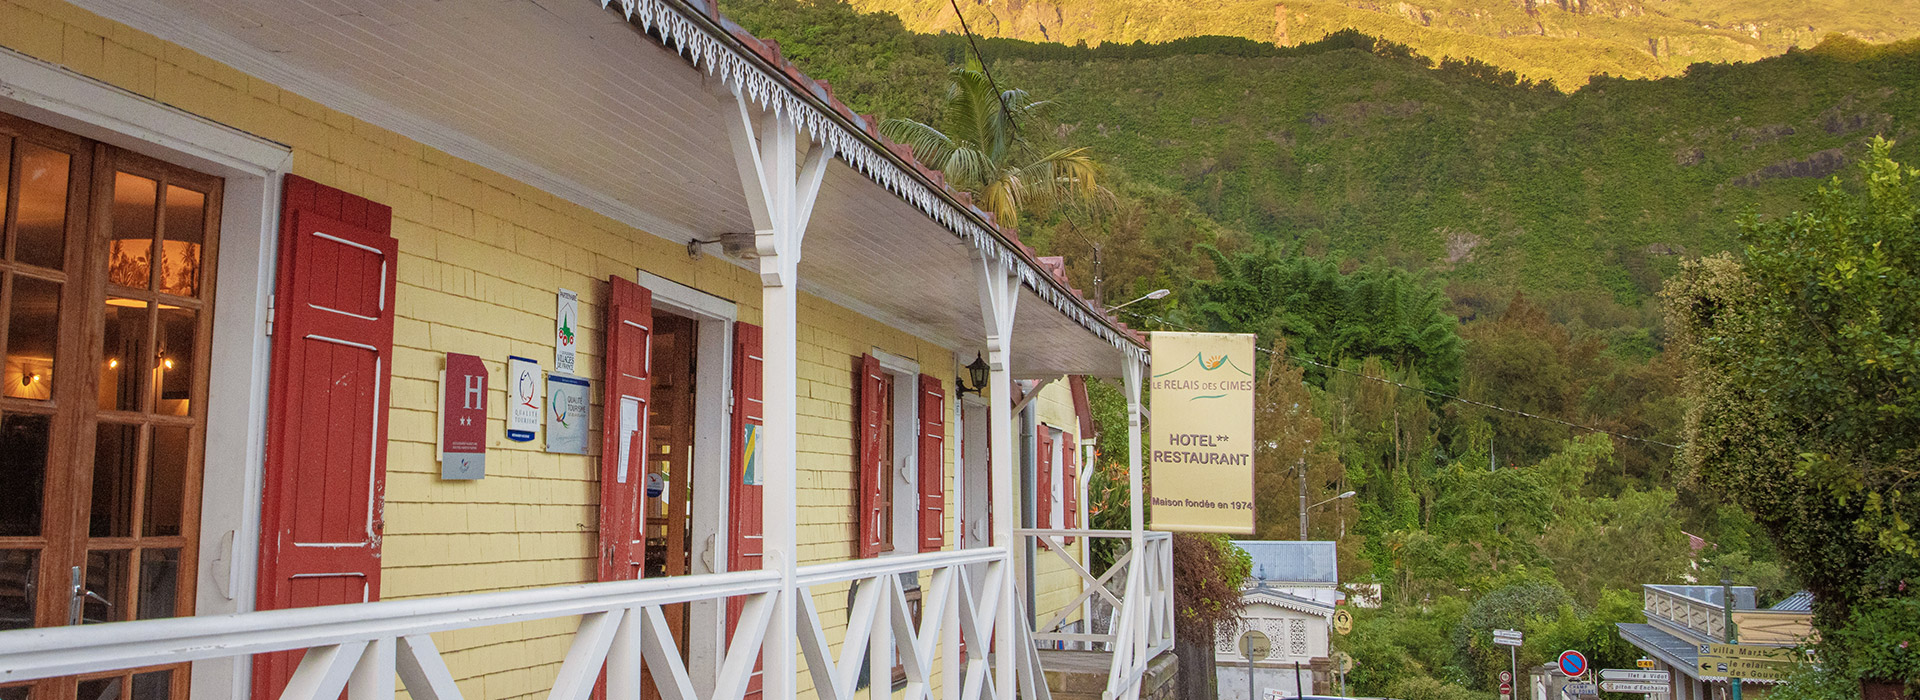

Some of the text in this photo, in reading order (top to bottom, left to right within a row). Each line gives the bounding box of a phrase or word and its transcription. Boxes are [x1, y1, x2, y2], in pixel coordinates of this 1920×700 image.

[557, 353, 574, 364] VILLAGES
[1152, 380, 1252, 391] LE RELAIS DES CIMES
[463, 375, 484, 410] H
[567, 404, 586, 413] TOURISME
[515, 416, 538, 424] TOURISME
[1153, 450, 1250, 466] RESTAURANT
[1152, 497, 1183, 507] Maison
[1185, 498, 1216, 509] fondée
[1230, 501, 1253, 511] 1974
[1713, 647, 1735, 655] villa
[1729, 660, 1768, 669] le relais
[1730, 669, 1746, 677] des
